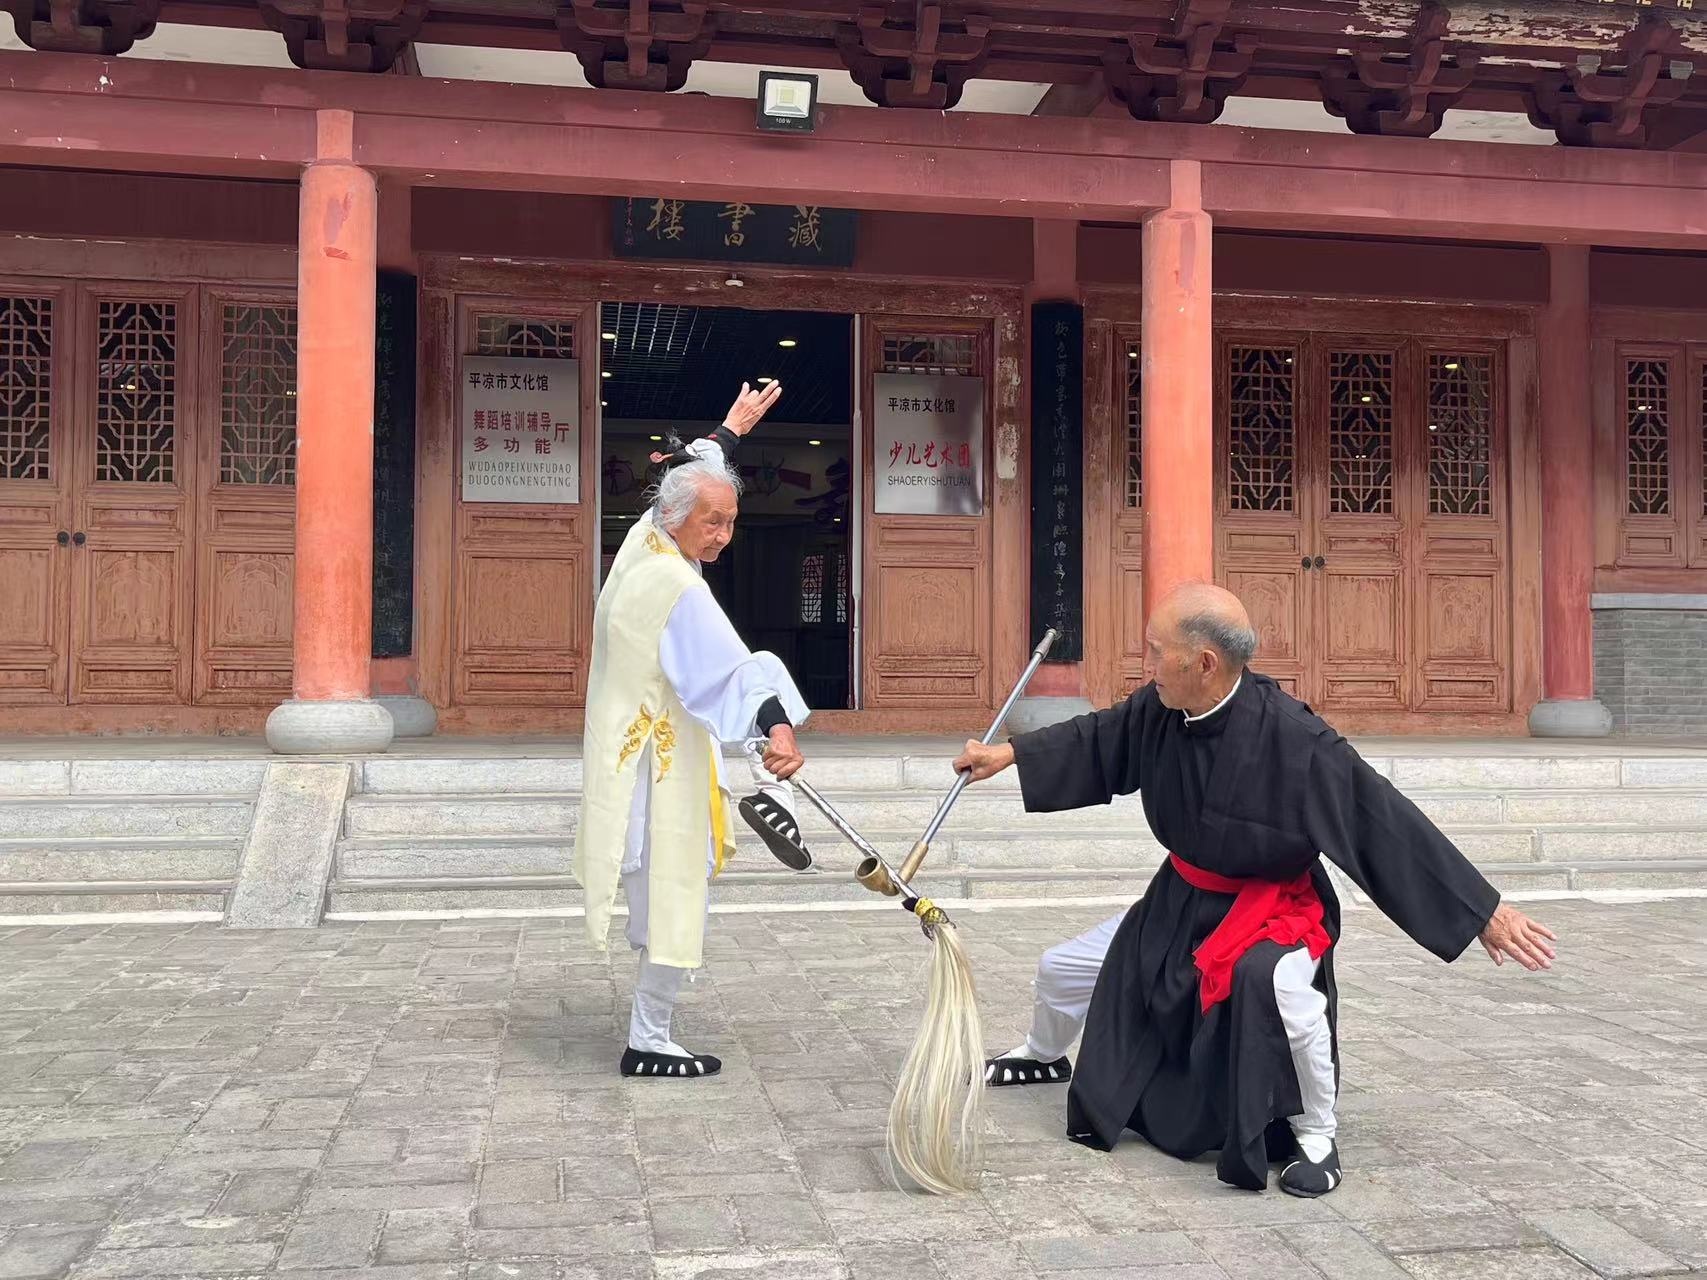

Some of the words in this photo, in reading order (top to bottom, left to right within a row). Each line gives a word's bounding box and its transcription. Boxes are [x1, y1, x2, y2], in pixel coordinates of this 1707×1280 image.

[469, 372, 549, 391] 平凉市文化馆
[888, 397, 956, 413] 平凉市文化馆
[473, 409, 552, 432] 舞蹈培训辅导
[554, 423, 569, 443] 厅
[473, 436, 551, 454] 多功能
[888, 440, 971, 470] 少儿艺术团
[468, 461, 572, 474] WUDAOPEIXUNFUDAO
[468, 475, 571, 487] DUOGONGNENGTING
[888, 476, 971, 487] SHAOERYISHUTUAN
